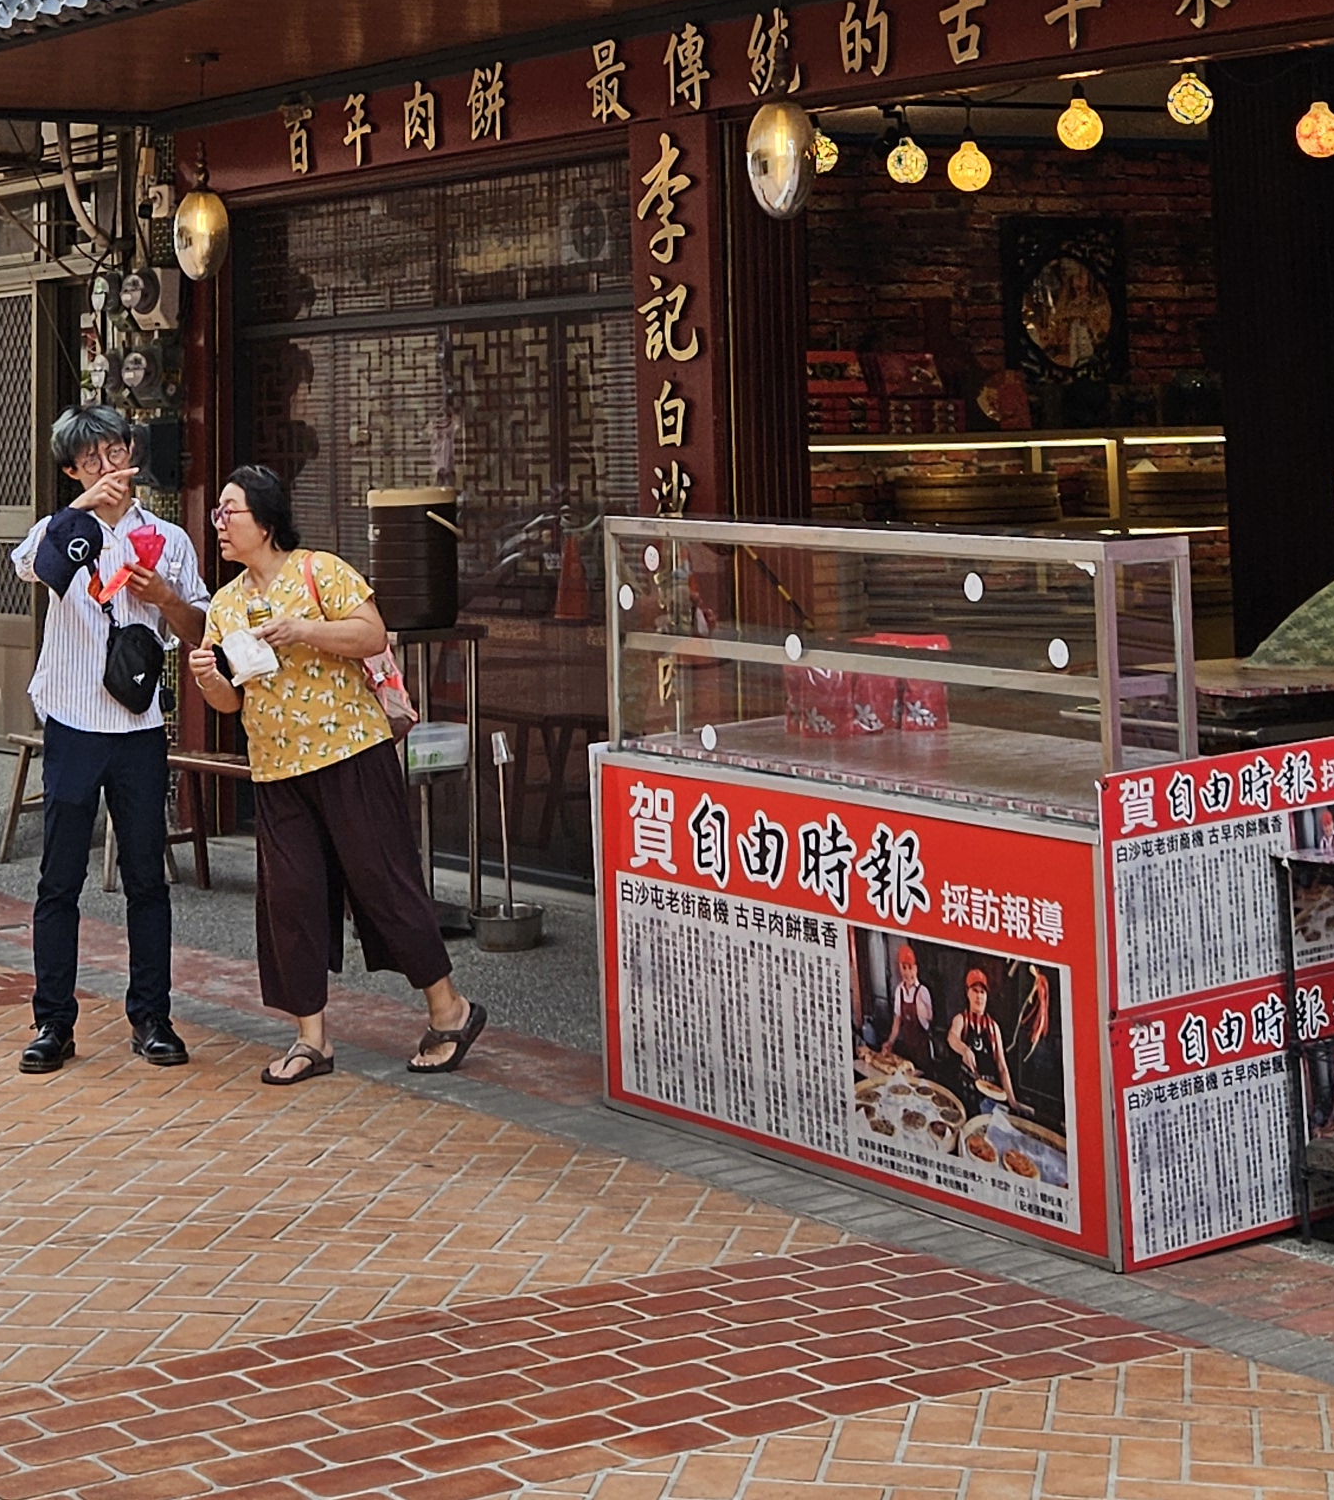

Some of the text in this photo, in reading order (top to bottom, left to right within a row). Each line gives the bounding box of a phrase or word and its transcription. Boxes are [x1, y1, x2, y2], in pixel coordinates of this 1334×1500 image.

[283, 64, 505, 174] 百年肉餅
[1119, 777, 1158, 834] 賀
[1166, 751, 1317, 824] 自由時報
[629, 781, 677, 875] 賀
[688, 793, 930, 924] 自由時報
[941, 881, 1064, 947] 採訪報導
[1116, 829, 1204, 864] 白沙屯老街商機
[620, 880, 838, 949] 白沙屯老街商機 古早肉餅飄香
[1129, 1020, 1169, 1080] 賀
[1177, 985, 1329, 1067] 自由時報
[1127, 1073, 1219, 1112] 白沙屯老街商機
